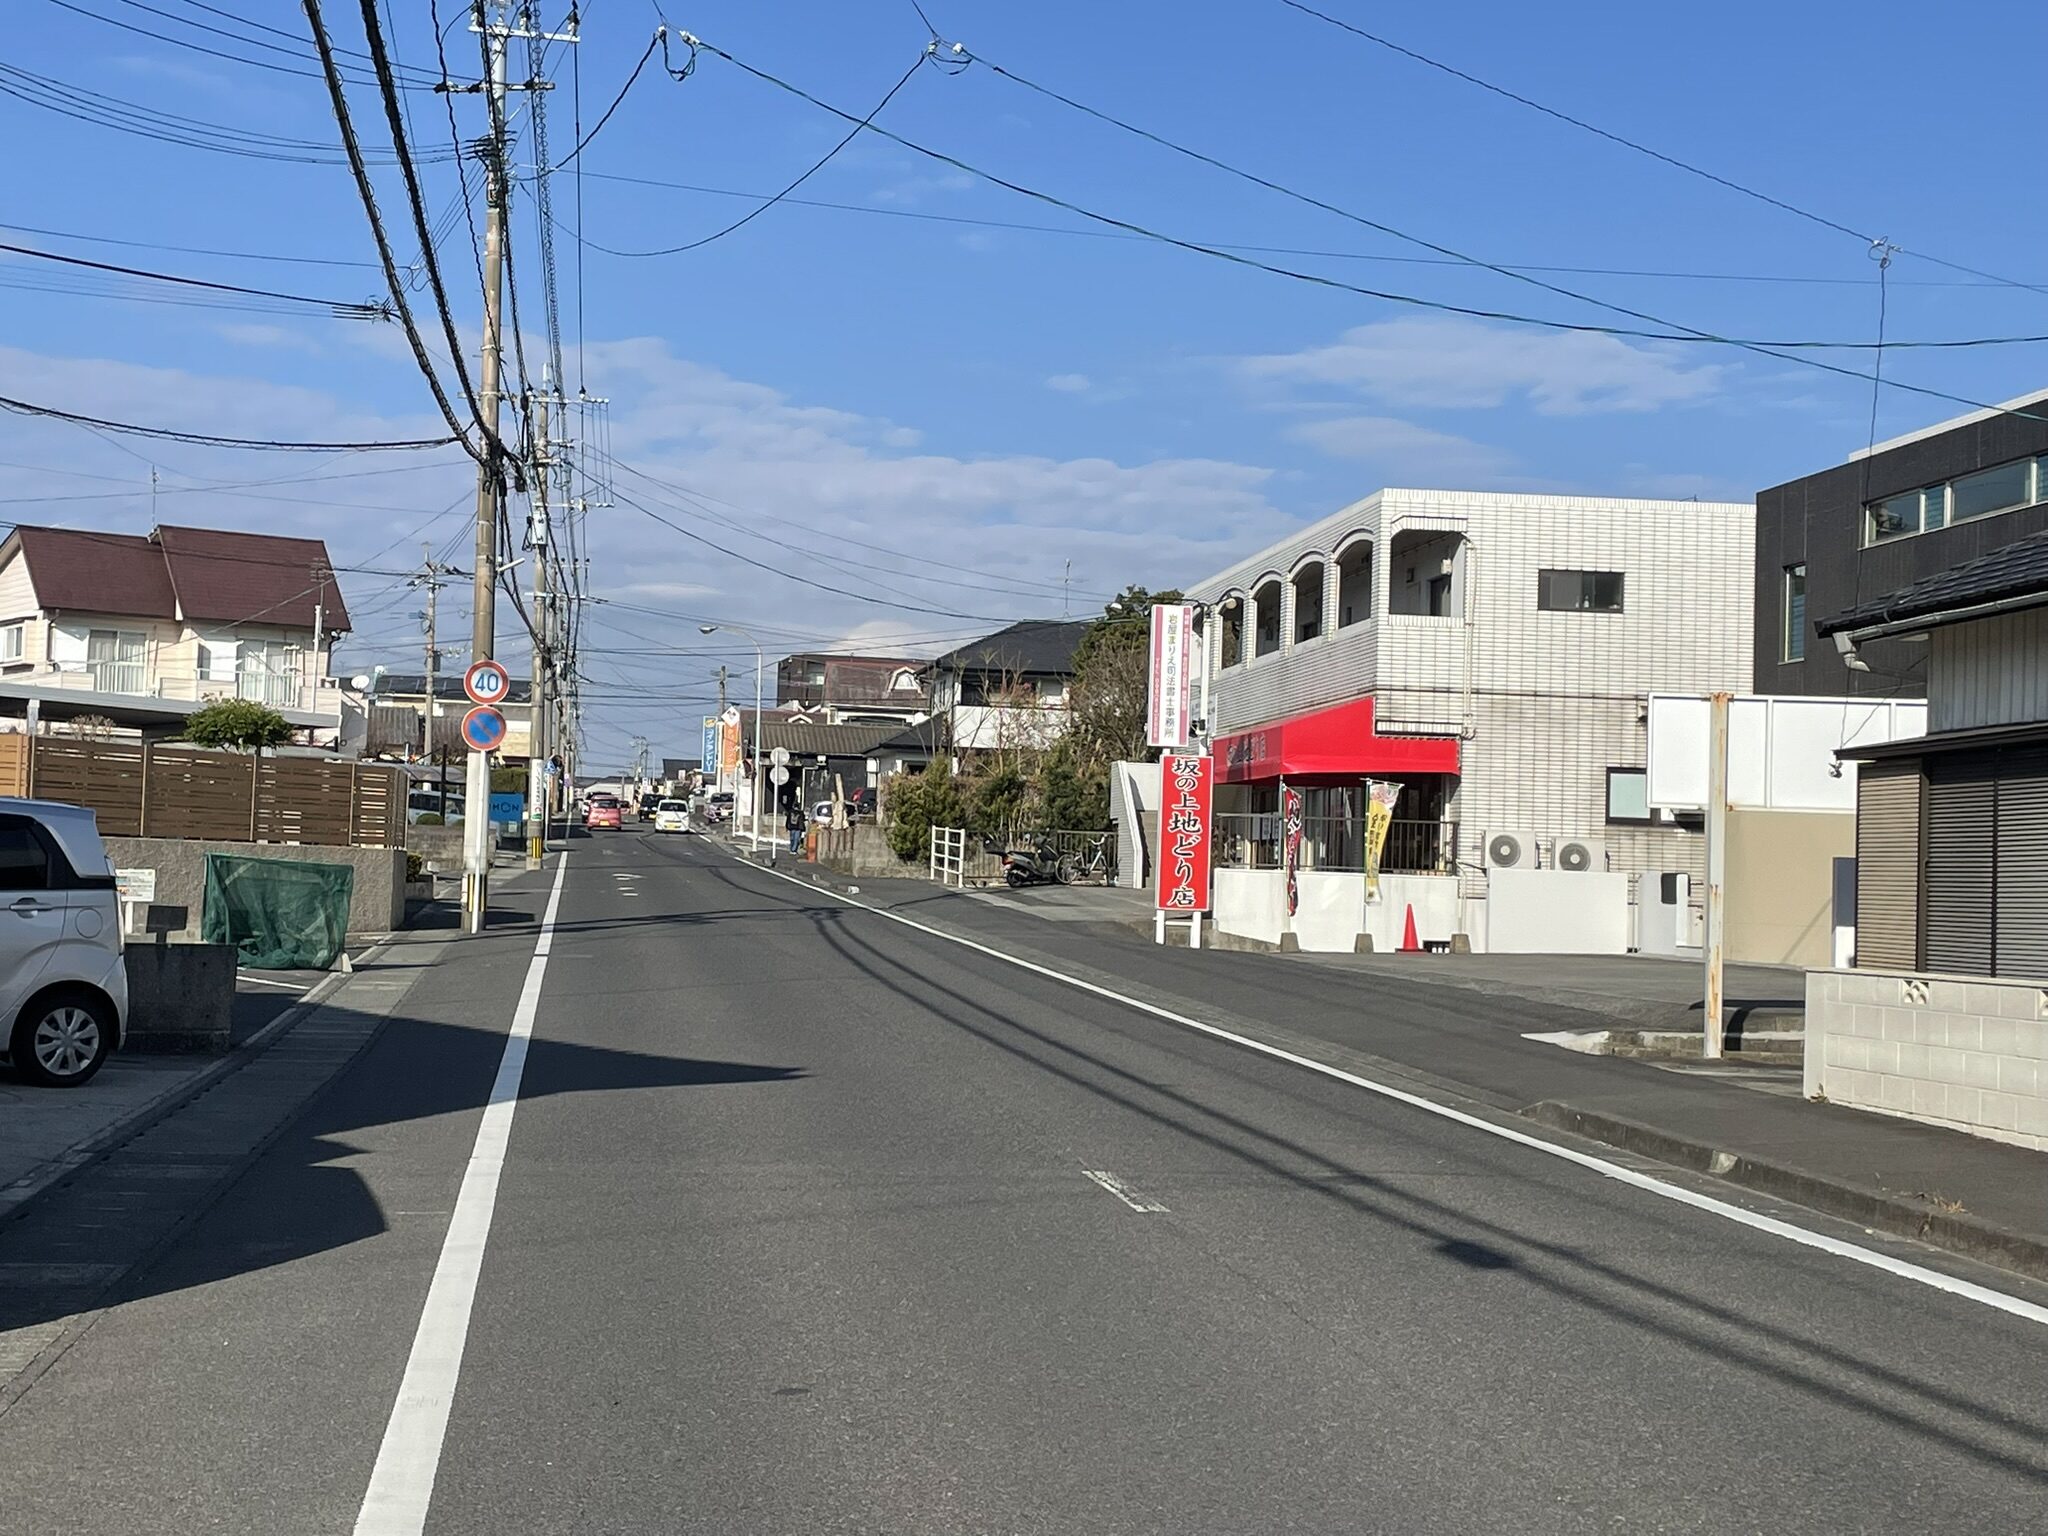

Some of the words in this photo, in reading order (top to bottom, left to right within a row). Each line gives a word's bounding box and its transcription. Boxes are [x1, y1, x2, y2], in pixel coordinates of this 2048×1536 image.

[474, 673, 500, 692] 40
[1168, 757, 1202, 907] 坂の上地どり店
